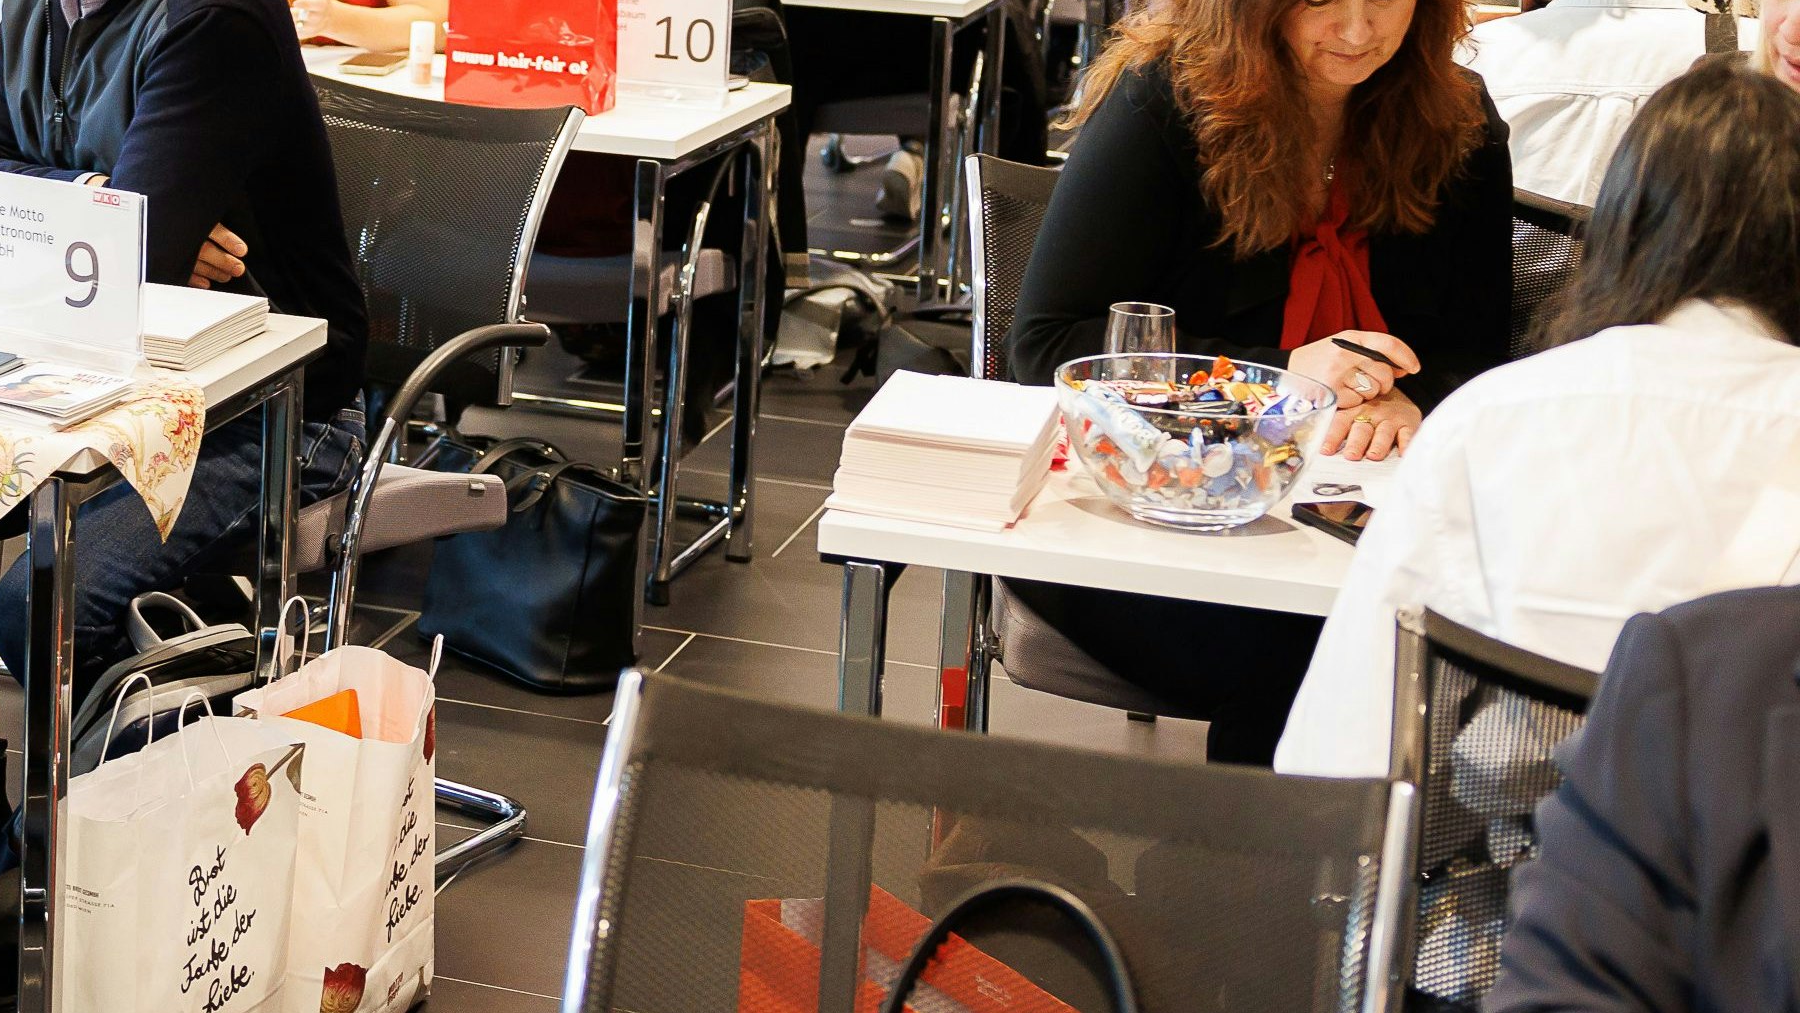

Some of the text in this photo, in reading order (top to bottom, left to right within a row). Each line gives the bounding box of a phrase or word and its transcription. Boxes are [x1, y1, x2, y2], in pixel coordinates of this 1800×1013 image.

[654, 16, 715, 63] 10
[9, 204, 45, 223] Motto
[65, 241, 100, 308] 9
[188, 844, 227, 907] Brot
[186, 883, 238, 947] ist die
[231, 908, 257, 948] der
